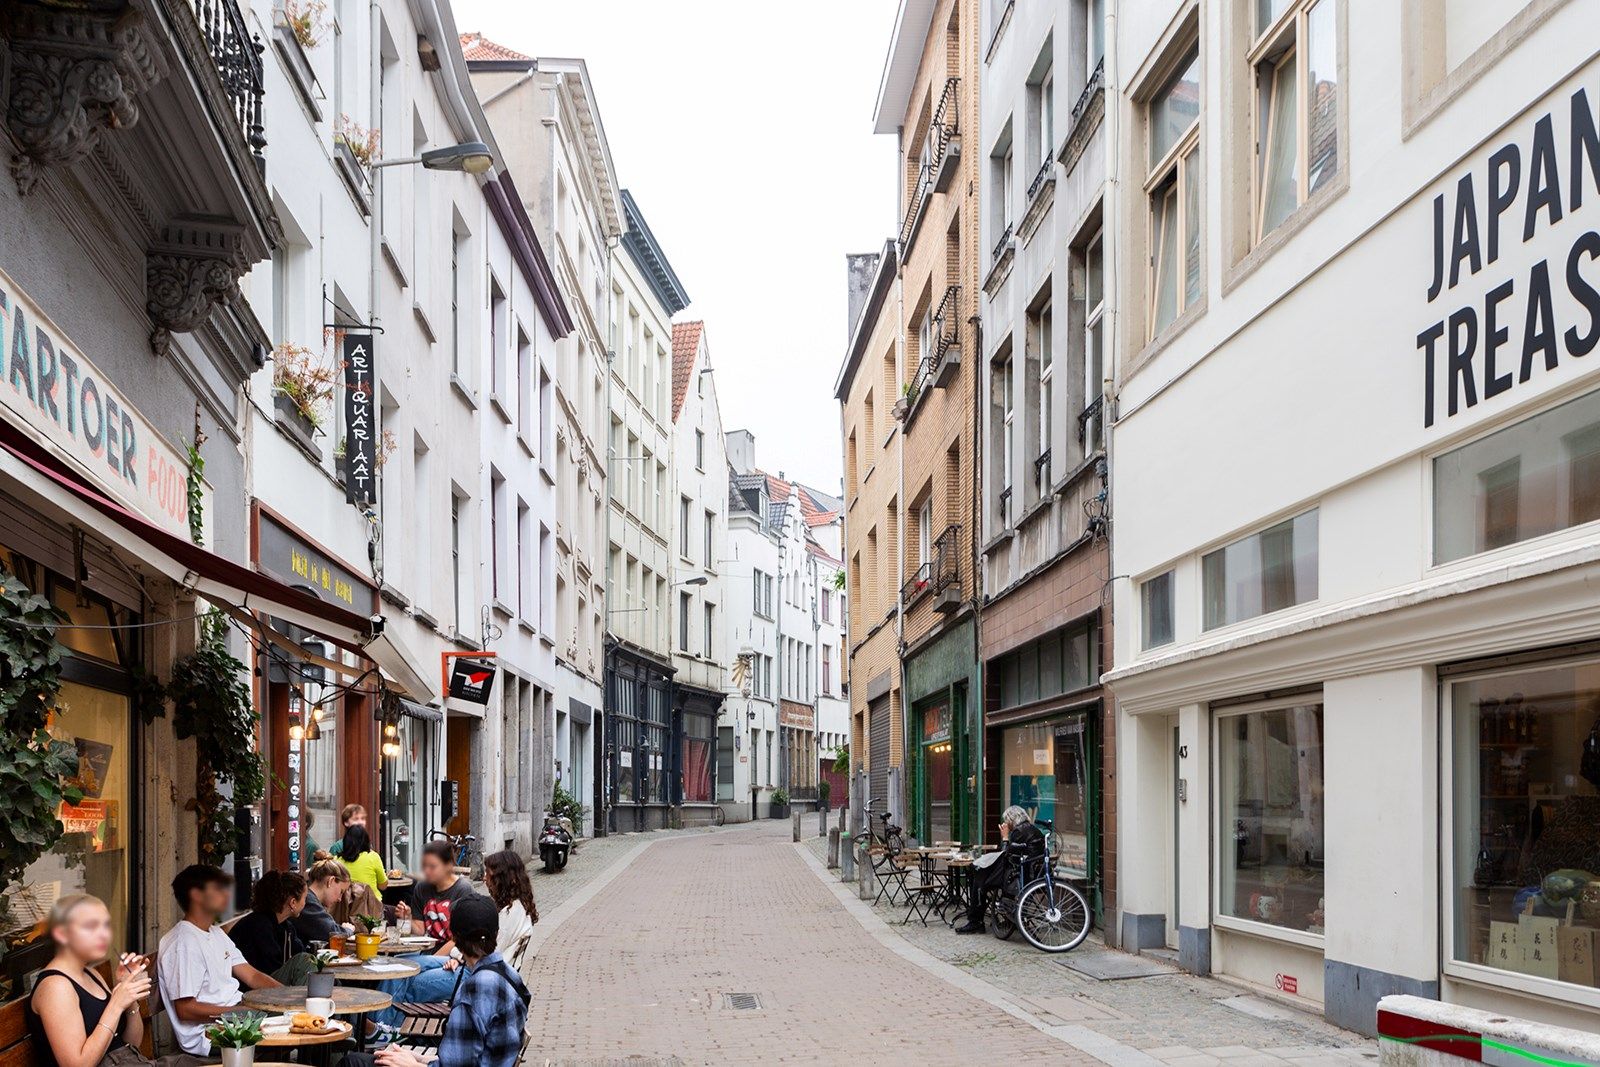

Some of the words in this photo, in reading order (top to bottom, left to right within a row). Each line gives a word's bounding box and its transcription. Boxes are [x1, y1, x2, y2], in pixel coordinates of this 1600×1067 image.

[1427, 87, 1600, 303] JAPAN
[1416, 231, 1600, 429] TREAS
[147, 447, 188, 525] FOOD
[351, 343, 369, 488] ARTIQUARIAAT
[1179, 745, 1188, 759] 43
